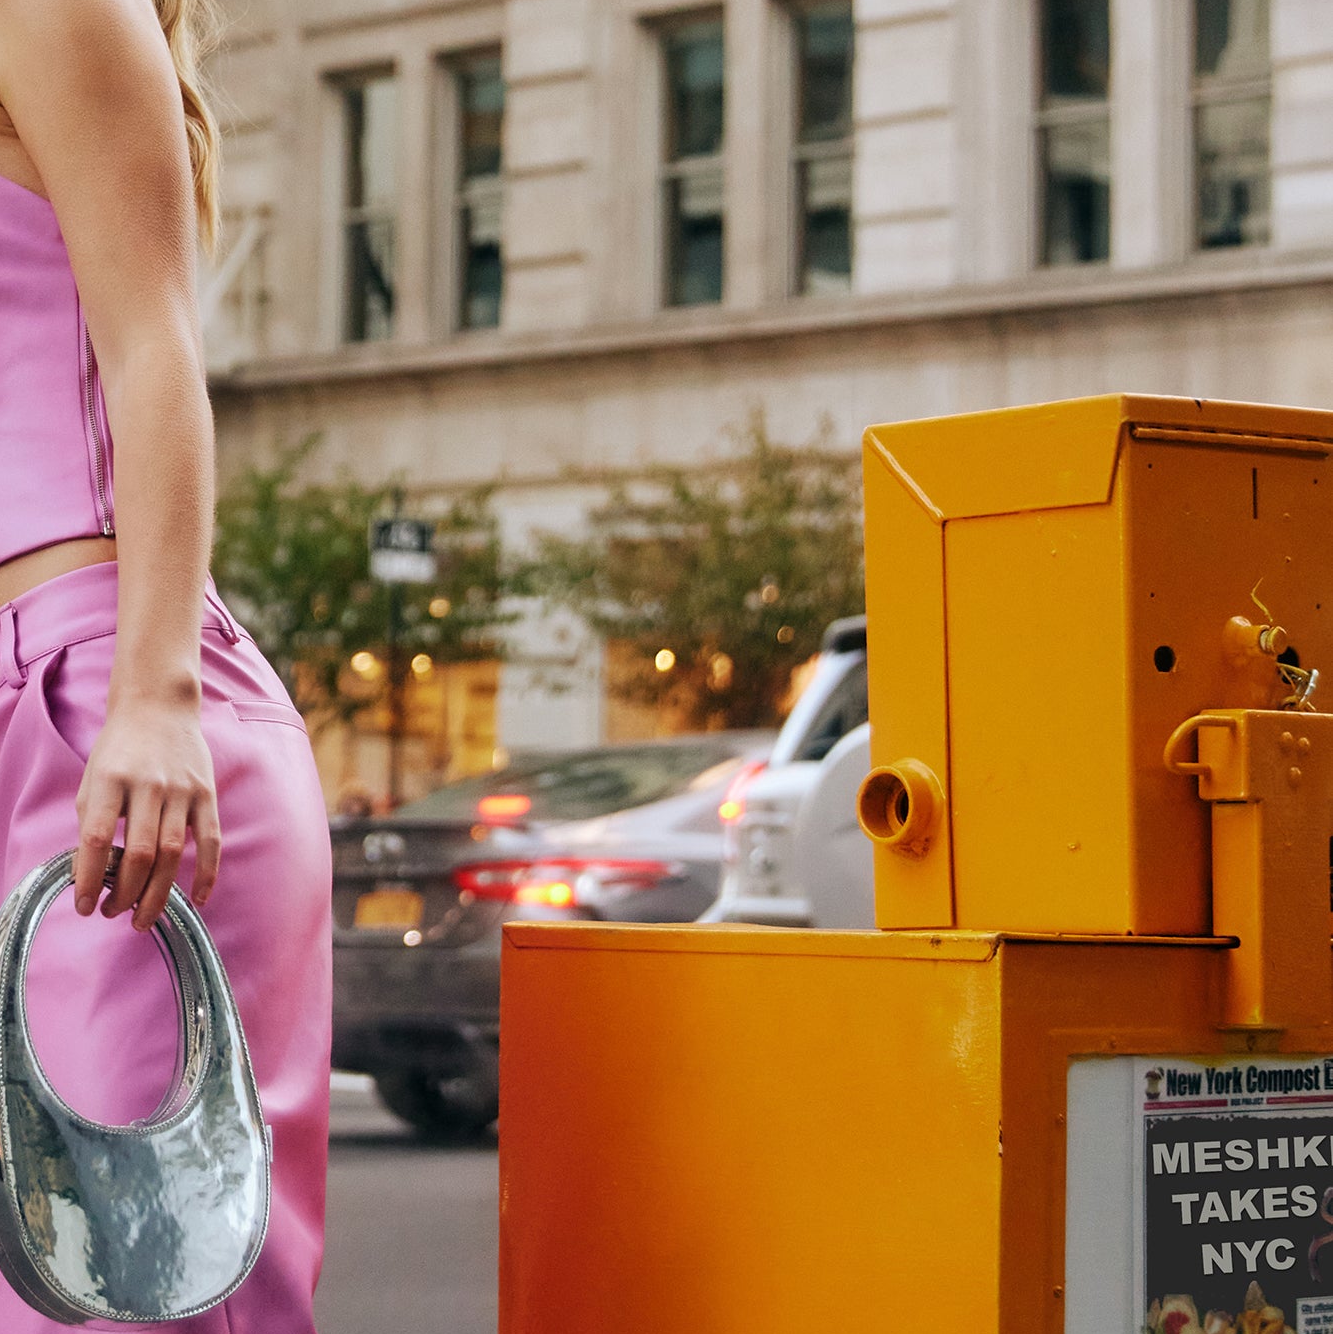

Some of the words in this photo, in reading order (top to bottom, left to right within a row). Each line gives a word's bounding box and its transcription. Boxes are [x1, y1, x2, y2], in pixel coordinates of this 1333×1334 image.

[1166, 1069, 1202, 1097] New
[1205, 1067, 1243, 1095] York
[1246, 1065, 1321, 1094] Compost
[1152, 1135, 1333, 1175] MESHK
[1171, 1184, 1318, 1225] TAKES
[1201, 1238, 1296, 1275] NYC
